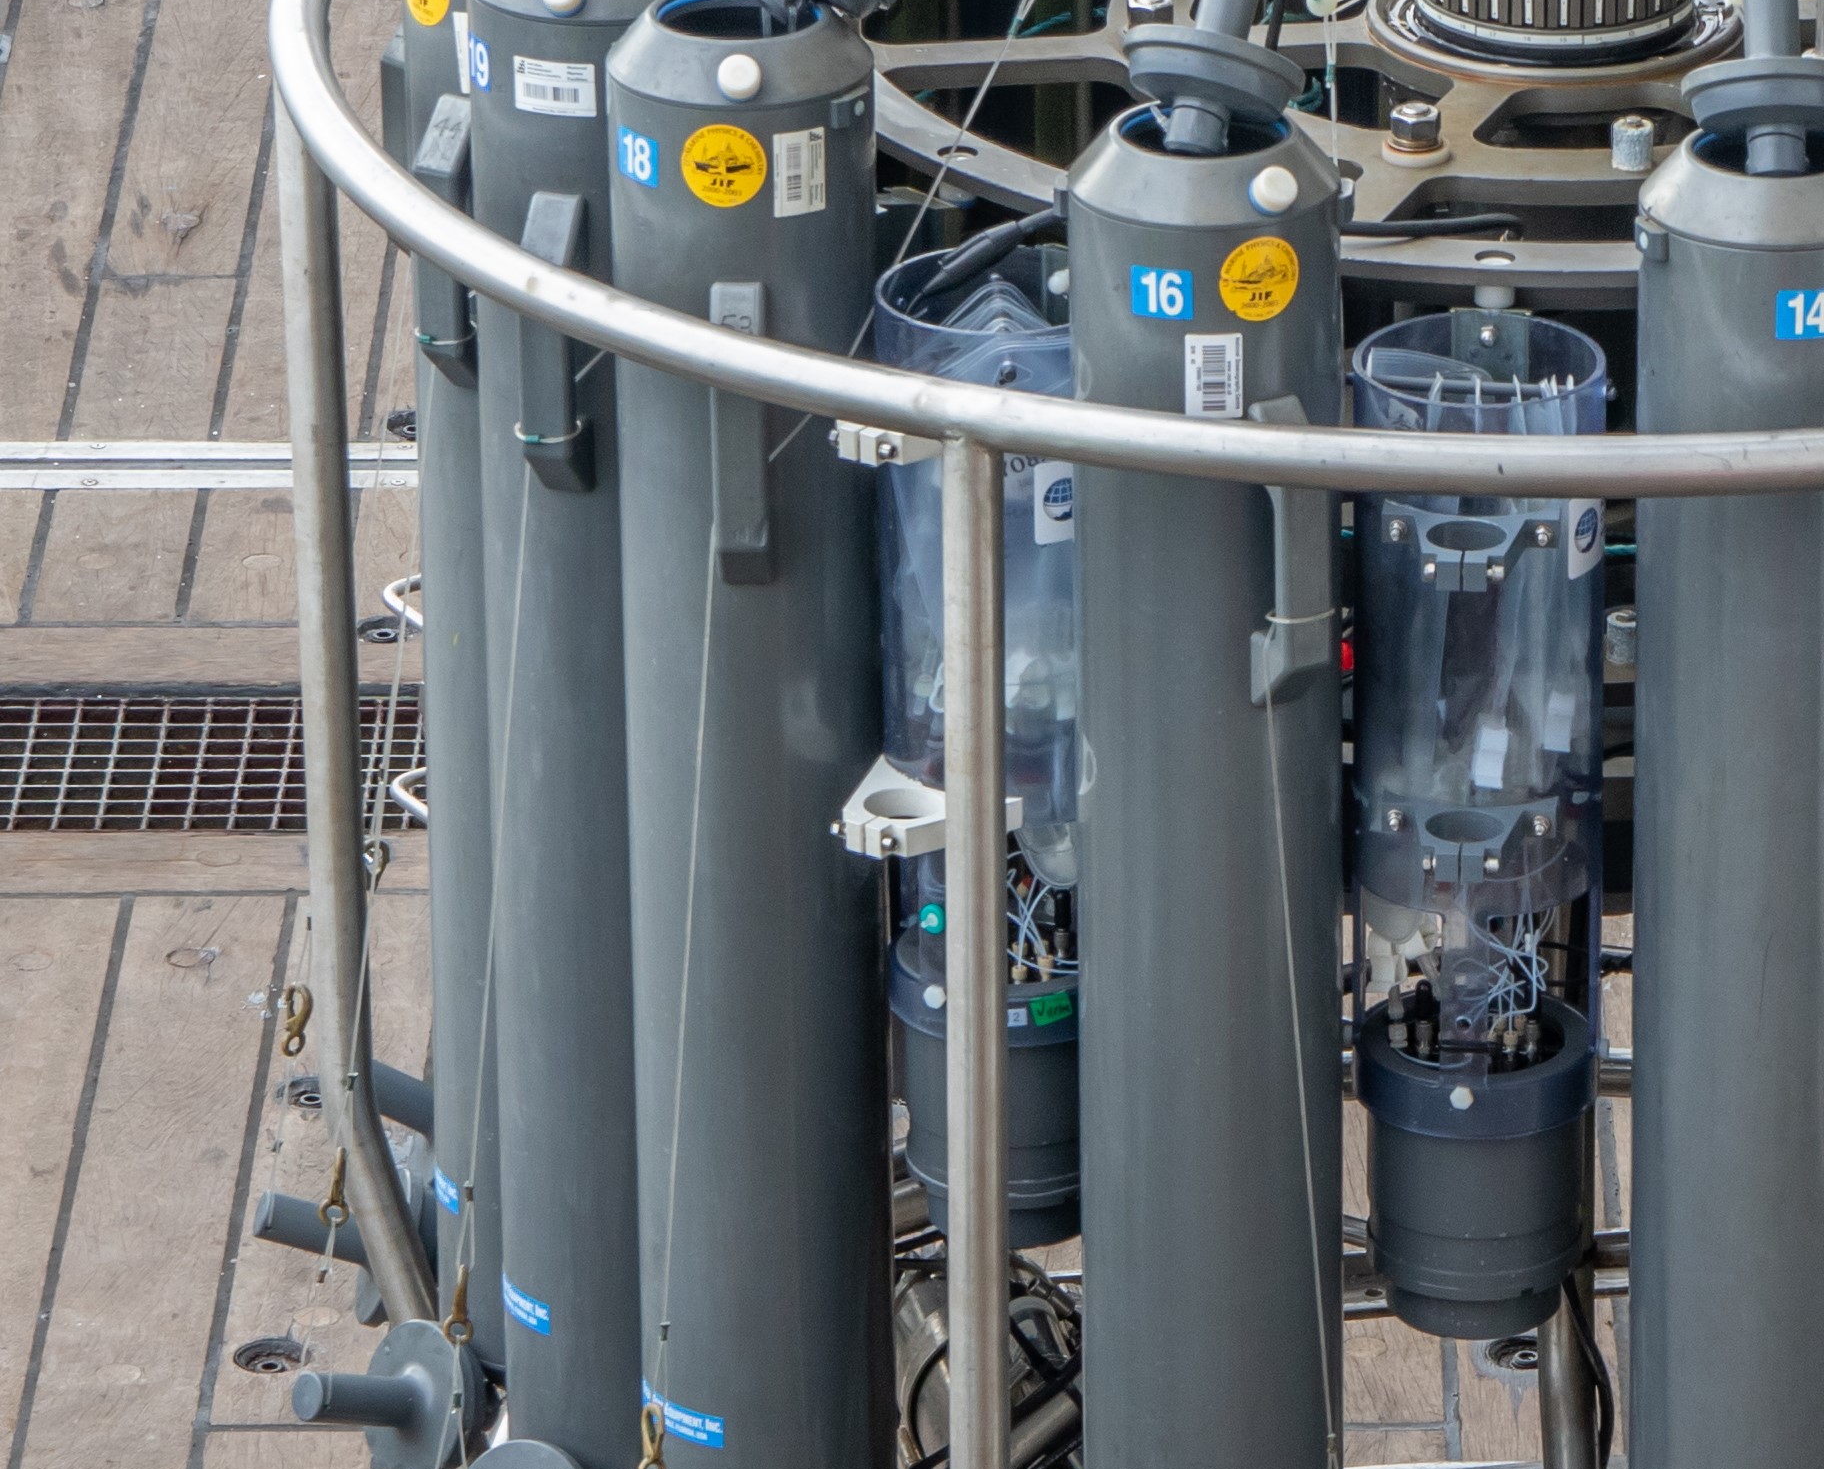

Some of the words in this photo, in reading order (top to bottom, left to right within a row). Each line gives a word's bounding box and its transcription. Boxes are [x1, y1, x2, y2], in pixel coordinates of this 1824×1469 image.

[470, 37, 489, 87] 19
[624, 134, 651, 181] 18
[710, 178, 735, 188] JIF
[1141, 272, 1184, 316] 16
[1249, 291, 1273, 301] JIF
[705, 1419, 723, 1434] INC.
